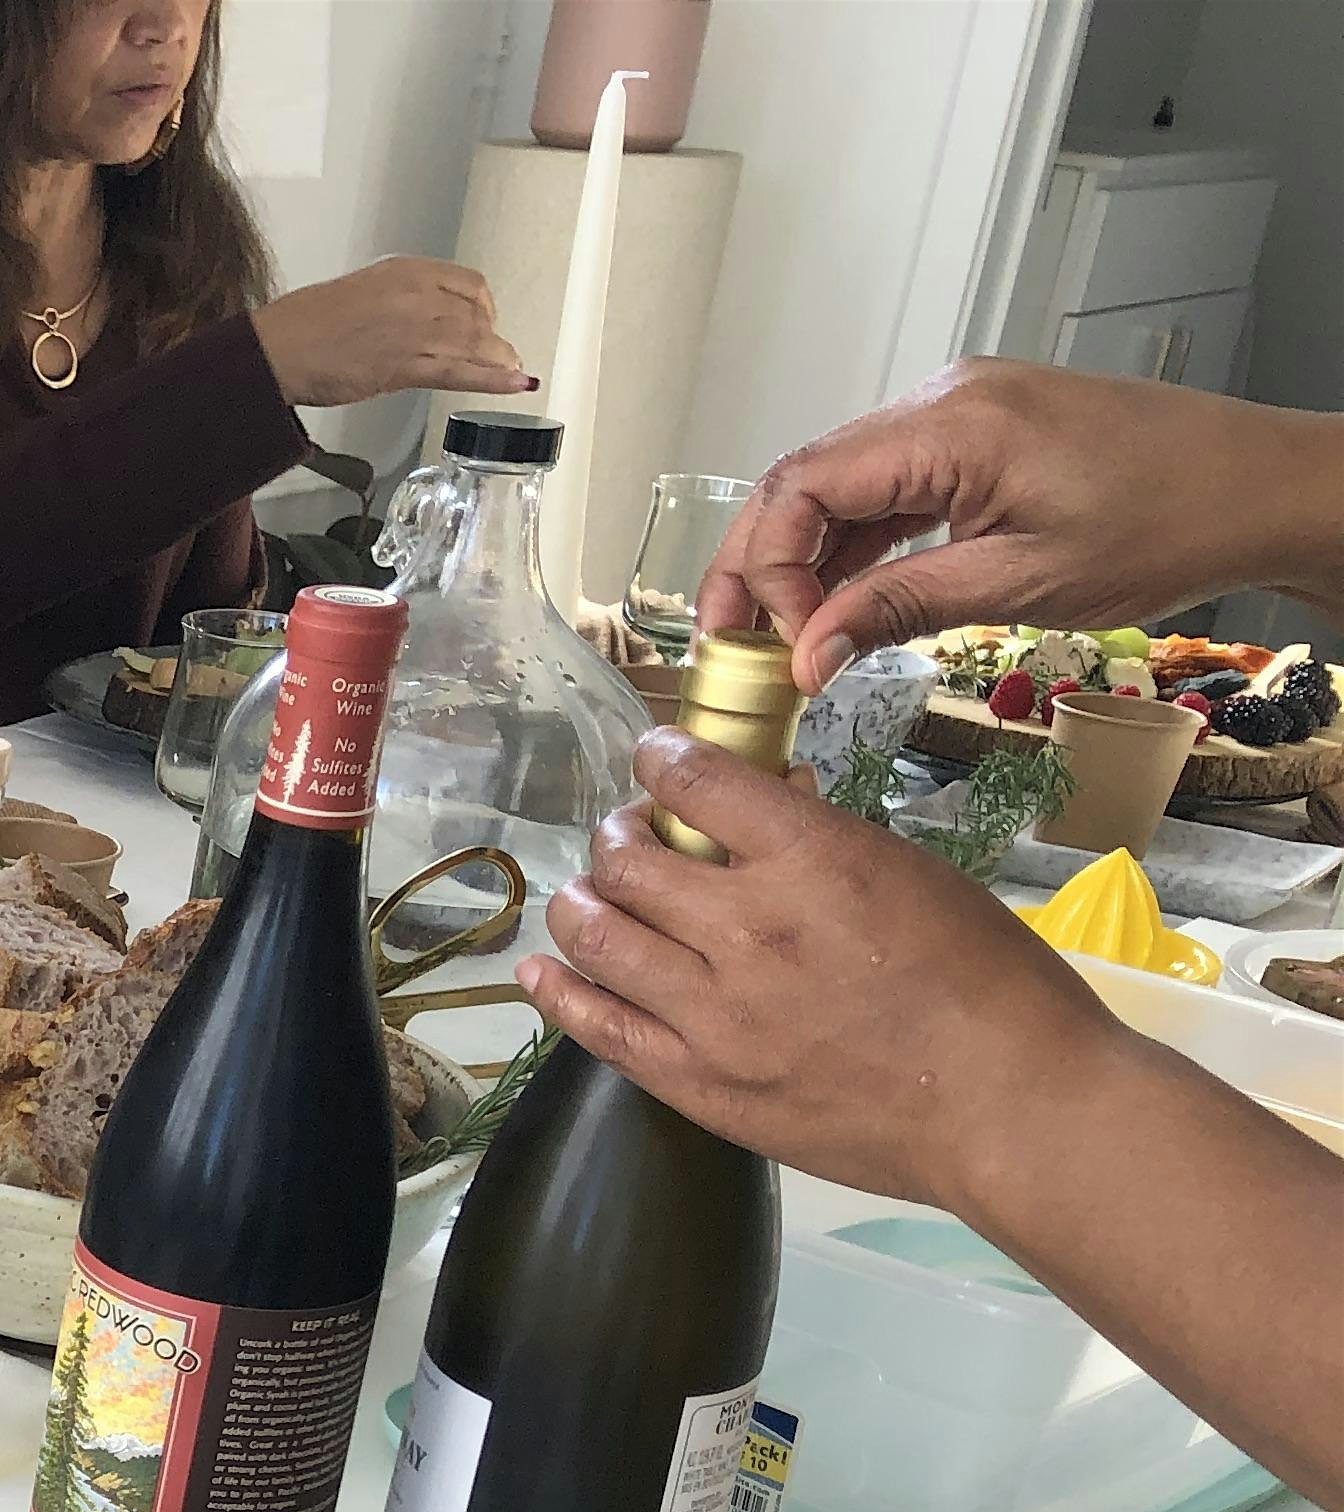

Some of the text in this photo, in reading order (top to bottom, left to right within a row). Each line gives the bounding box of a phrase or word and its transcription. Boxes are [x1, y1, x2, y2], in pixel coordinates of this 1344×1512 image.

[332, 678, 385, 698] Organic
[337, 700, 373, 716] Wine
[334, 737, 357, 753] No
[311, 757, 363, 776] Sulfites
[306, 779, 356, 797] Added
[78, 1278, 199, 1374] REDWOOD
[291, 1319, 322, 1332] KEEP
[229, 1388, 265, 1400] Organic
[720, 1400, 748, 1420] MON
[751, 1456, 768, 1472] 10
